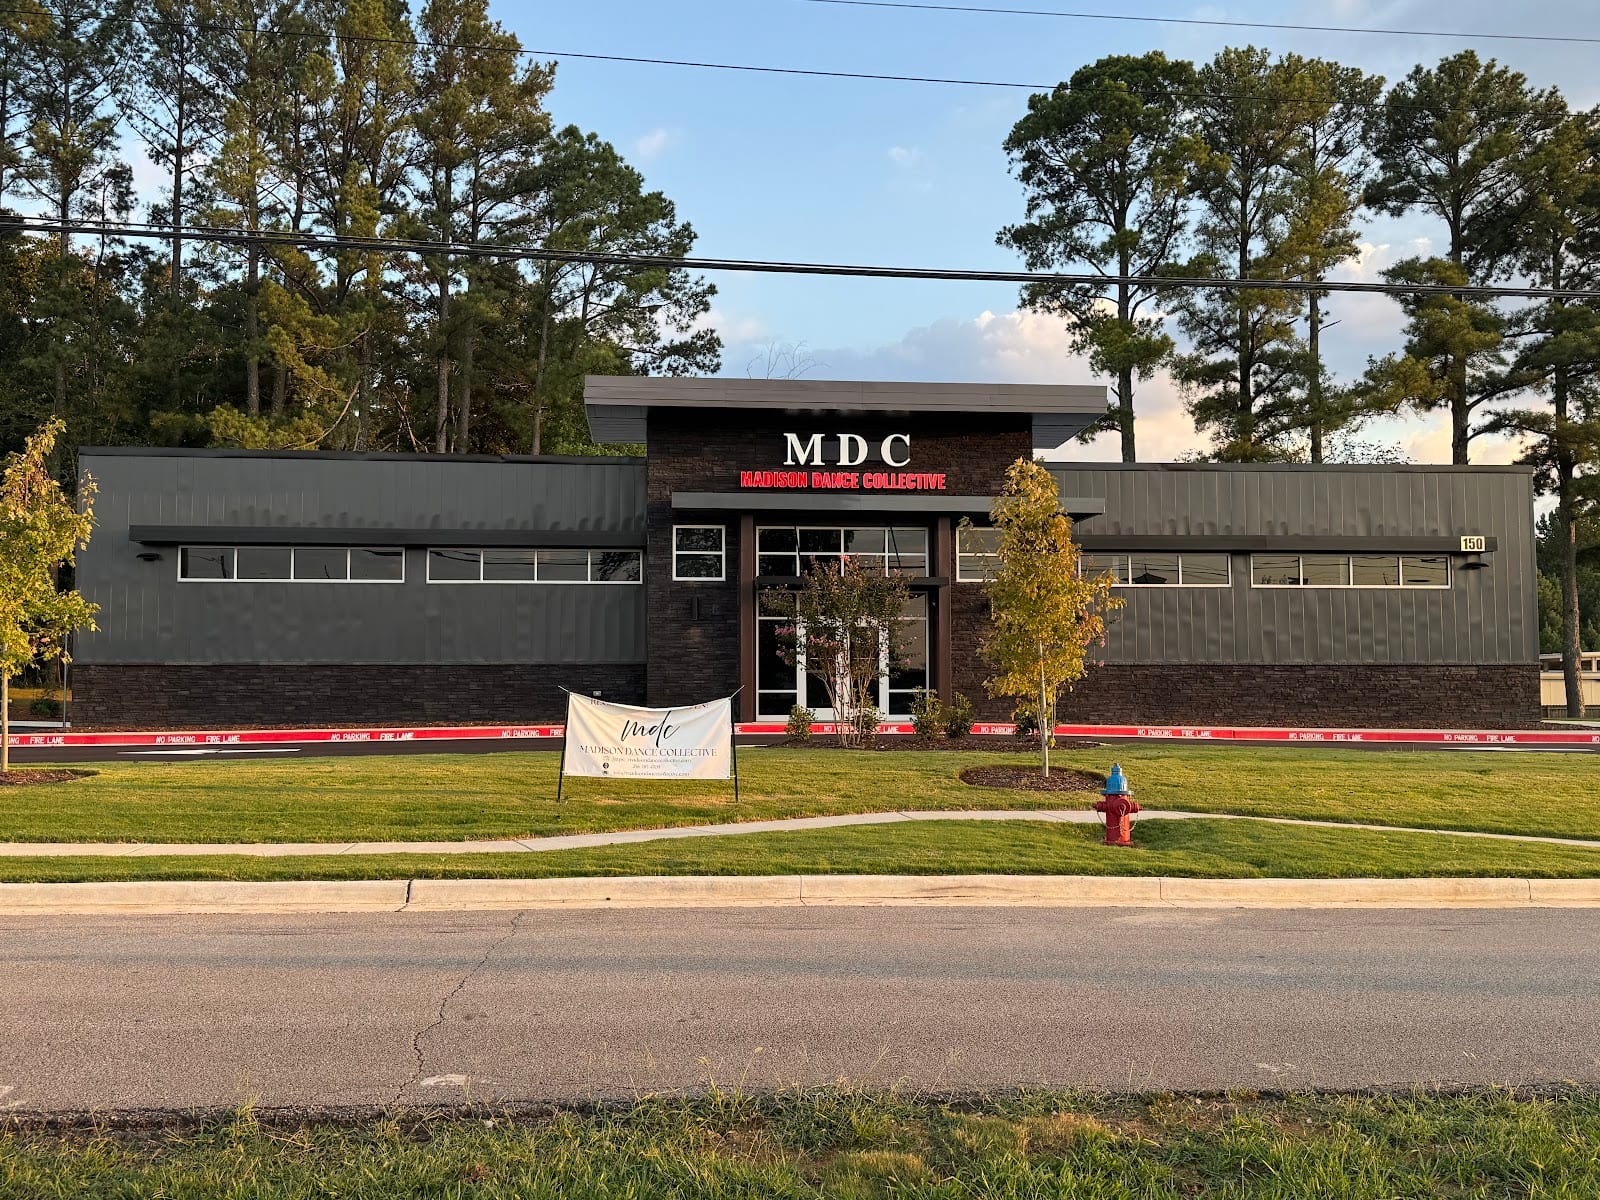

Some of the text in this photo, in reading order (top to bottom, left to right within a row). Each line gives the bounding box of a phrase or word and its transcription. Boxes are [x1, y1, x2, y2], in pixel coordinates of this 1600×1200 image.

[741, 471, 946, 489] MADISON DANCE COLLECTIVE
[1463, 537, 1483, 550] 150
[513, 729, 540, 737] PARKING
[549, 728, 563, 736] FIRE
[620, 710, 681, 748] mdc
[1148, 729, 1172, 737] PARKING
[30, 736, 64, 745] FIRE LANE
[155, 735, 240, 744] NO PARKING FIRE LANE
[331, 732, 414, 741] NO PARKING FIRE LANE
[1332, 733, 1346, 741] FIRE
[1454, 734, 1478, 742] PARKING
[579, 745, 718, 757] MADISON DANCE COLLECTIVE
